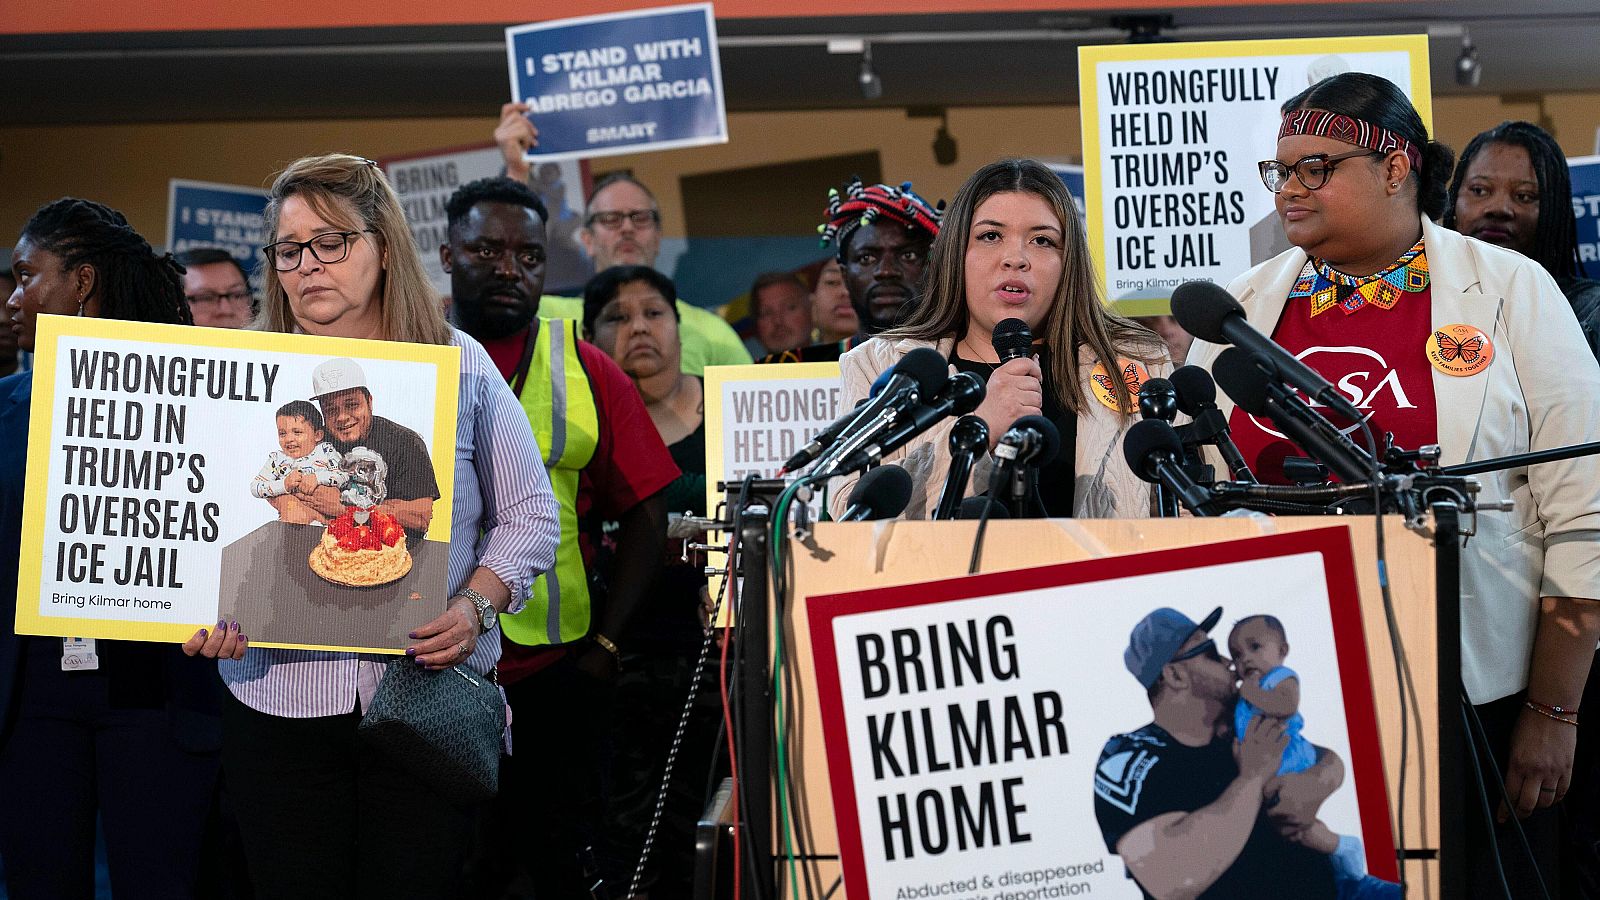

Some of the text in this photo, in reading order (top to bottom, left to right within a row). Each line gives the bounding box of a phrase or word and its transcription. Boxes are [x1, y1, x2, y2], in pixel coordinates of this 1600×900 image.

[525, 38, 702, 76] I STAND WITH
[568, 63, 662, 90] KILMAR
[1108, 67, 1279, 106] WRONGFULLY
[526, 78, 712, 114] ABREGO GARCIA
[586, 122, 657, 143] SMART
[1110, 110, 1208, 147] HELD IN
[396, 162, 459, 193] BRING
[1110, 150, 1229, 188] TRUMP'S
[181, 206, 191, 224] I
[1114, 191, 1245, 229] OVERSEAS
[1116, 233, 1221, 270] ICE JAIL
[1116, 279, 1143, 291] Bring
[1146, 277, 1179, 288] Kilmar
[70, 349, 280, 402] WRONGFULLY
[1431, 351, 1487, 372] KEEP FAMILIES TOGETHER
[732, 387, 840, 423] WRONGF
[1102, 394, 1116, 405] KEEP
[65, 396, 187, 444] HELD IN
[733, 428, 795, 463] HELD
[62, 445, 206, 493] TRUMP'S
[59, 493, 220, 542] OVERSEAS
[56, 542, 183, 589] ICE JAIL
[52, 593, 172, 610] Bring Kilmar home
[855, 614, 1021, 700] BRING
[866, 690, 1070, 780] KILMAR
[877, 776, 1033, 862] HOME
[896, 859, 1105, 900] Abducted & disappeared
[993, 879, 1092, 900] deportation
